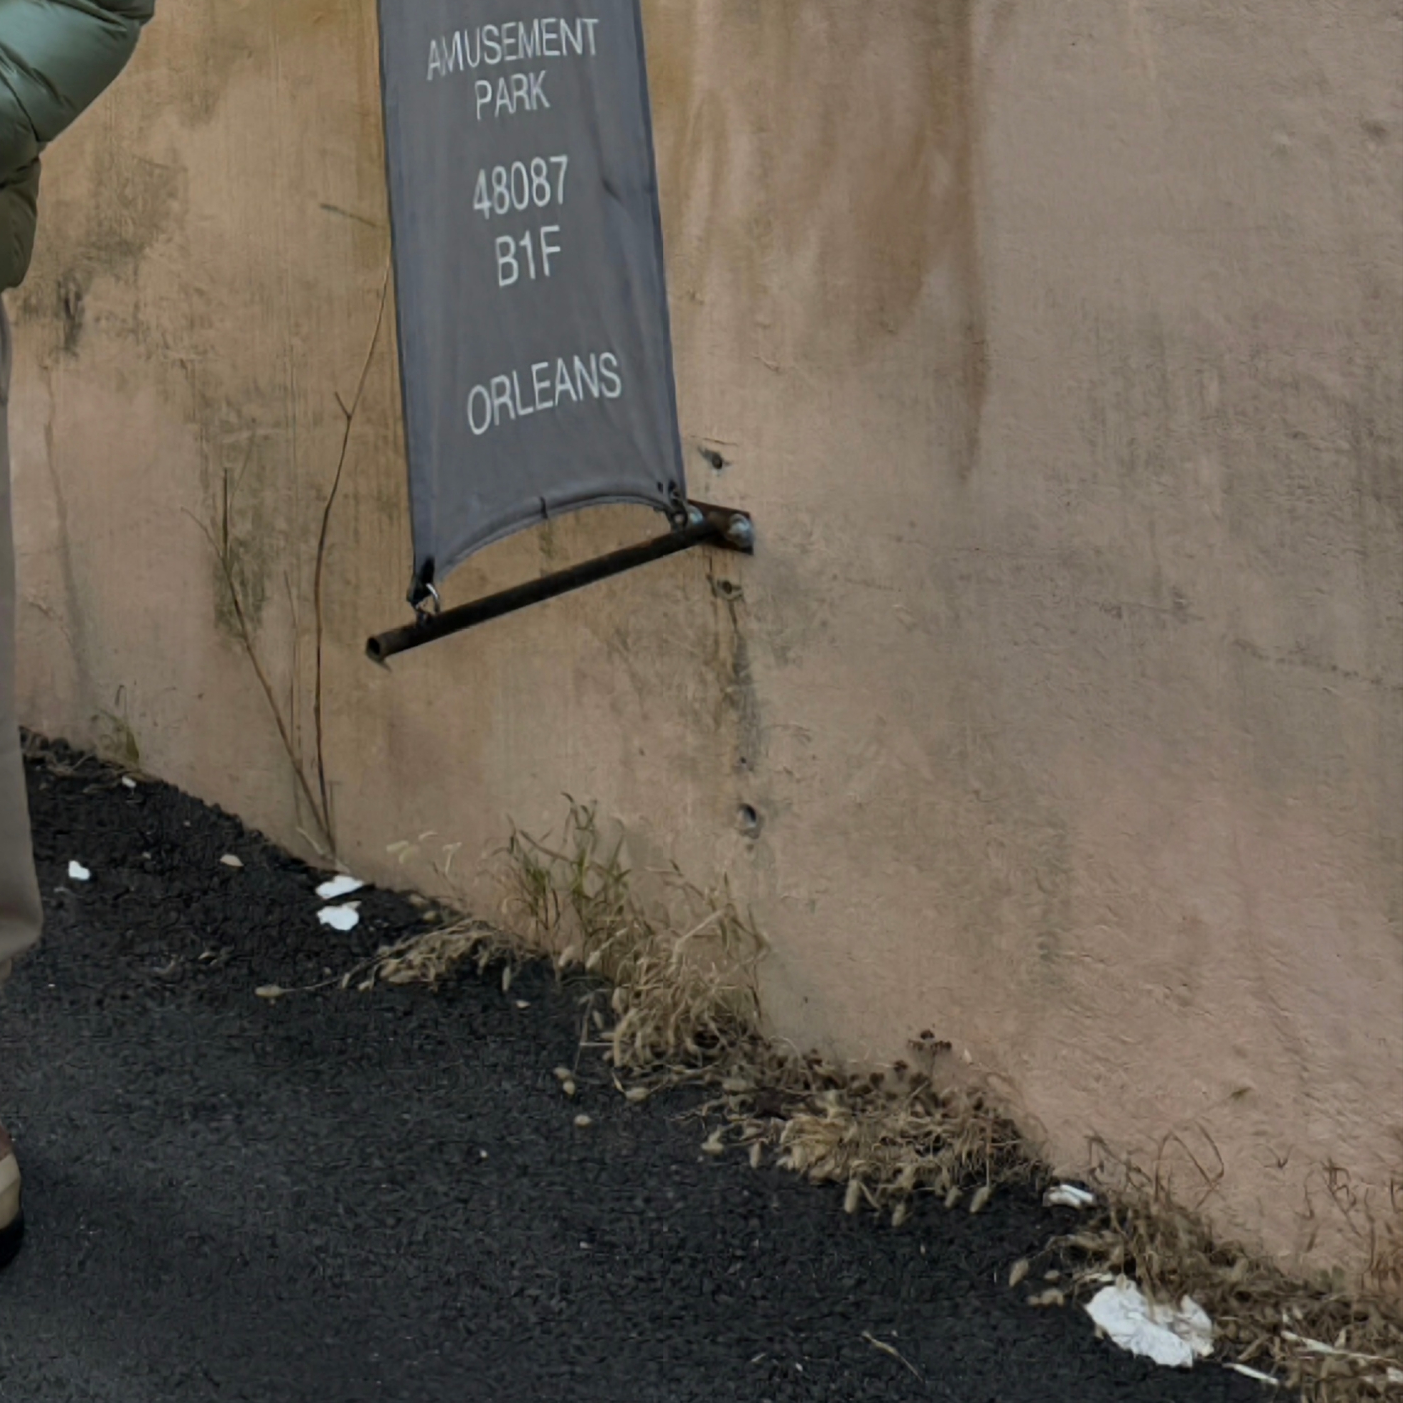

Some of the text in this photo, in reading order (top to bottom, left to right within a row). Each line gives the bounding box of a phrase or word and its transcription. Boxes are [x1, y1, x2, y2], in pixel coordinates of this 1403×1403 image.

[426, 17, 600, 81] AMUSEMENT
[474, 70, 550, 120] PARK
[472, 154, 569, 220] 48087
[496, 225, 562, 287] B1F
[466, 351, 622, 435] ORLEANS
